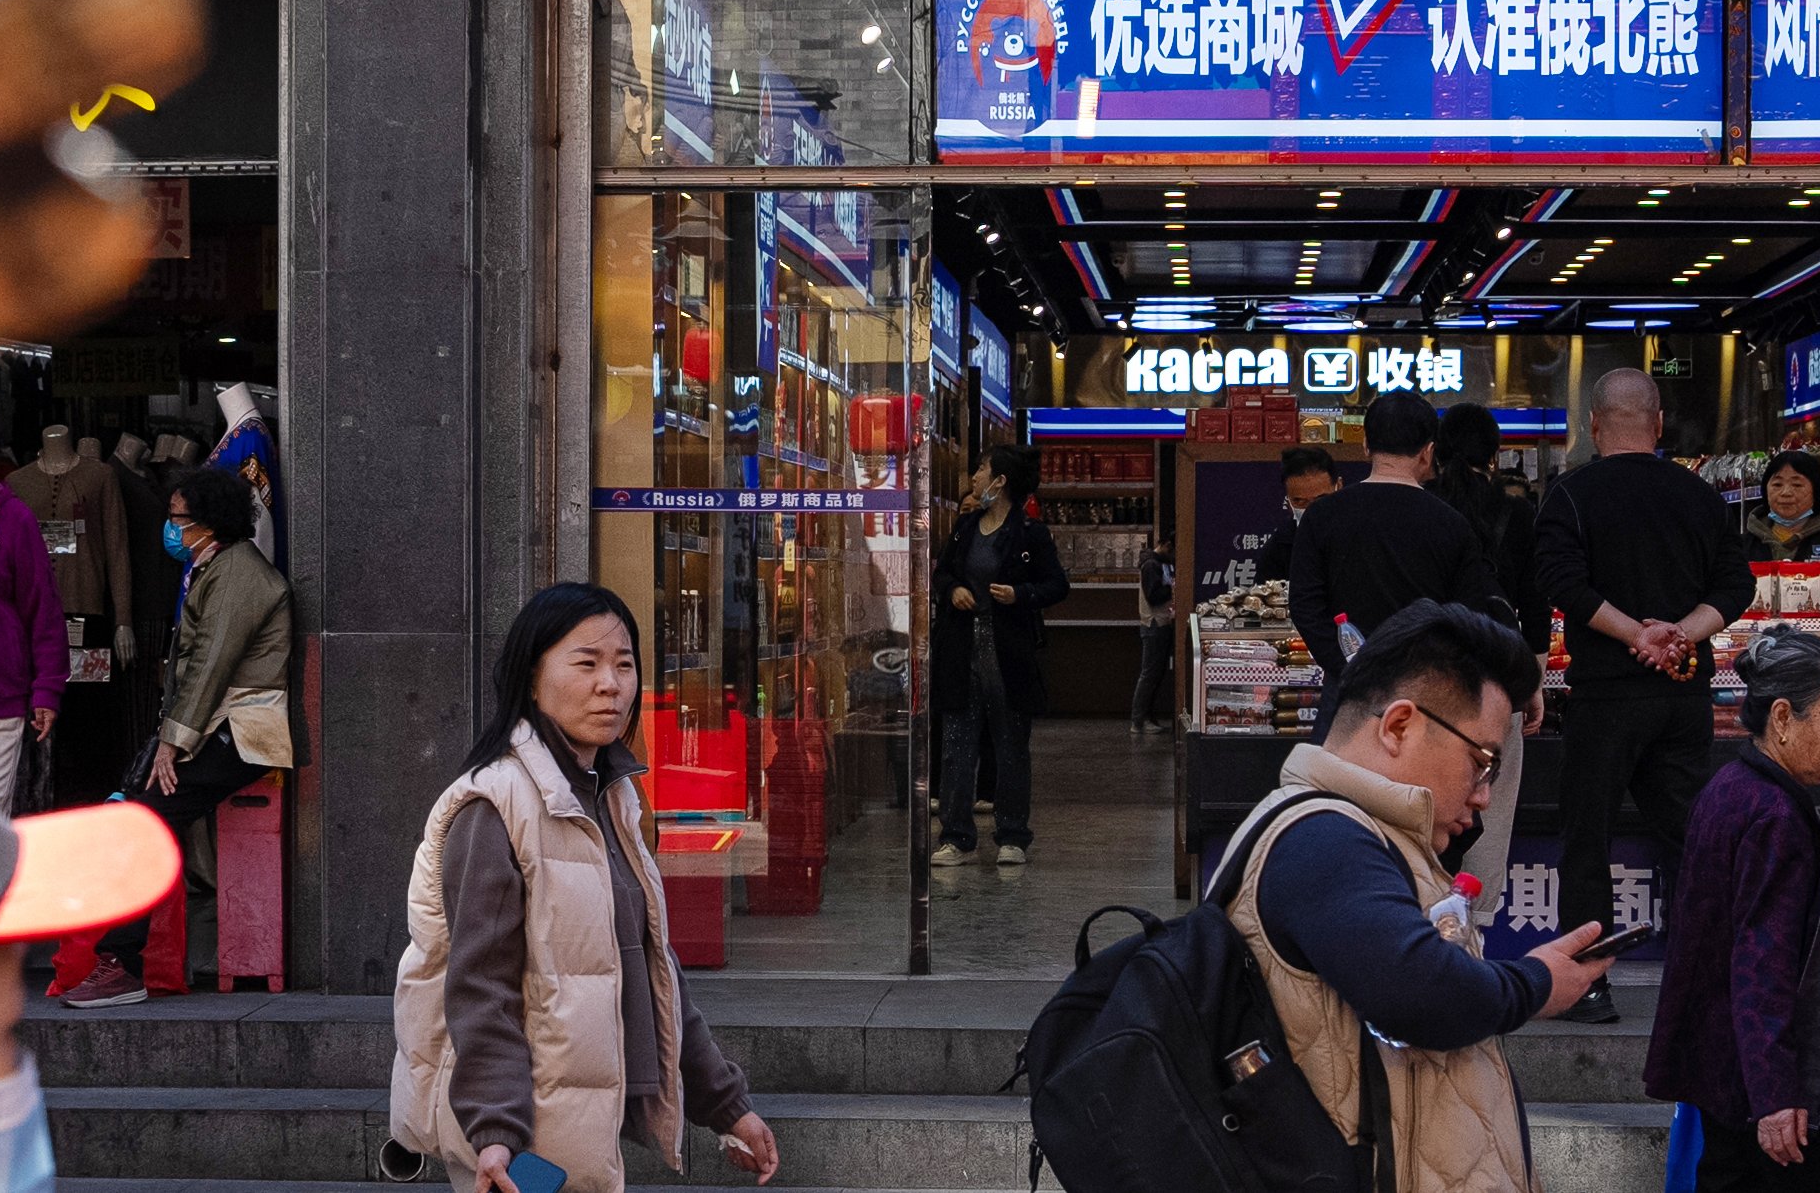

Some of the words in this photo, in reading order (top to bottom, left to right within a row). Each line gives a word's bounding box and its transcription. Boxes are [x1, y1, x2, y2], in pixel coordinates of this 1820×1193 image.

[989, 105, 1036, 121] RUSSIA
[1366, 346, 1464, 393] 收银
[652, 491, 714, 507] Russia
[738, 492, 864, 508] 俄罗斯商品馆
